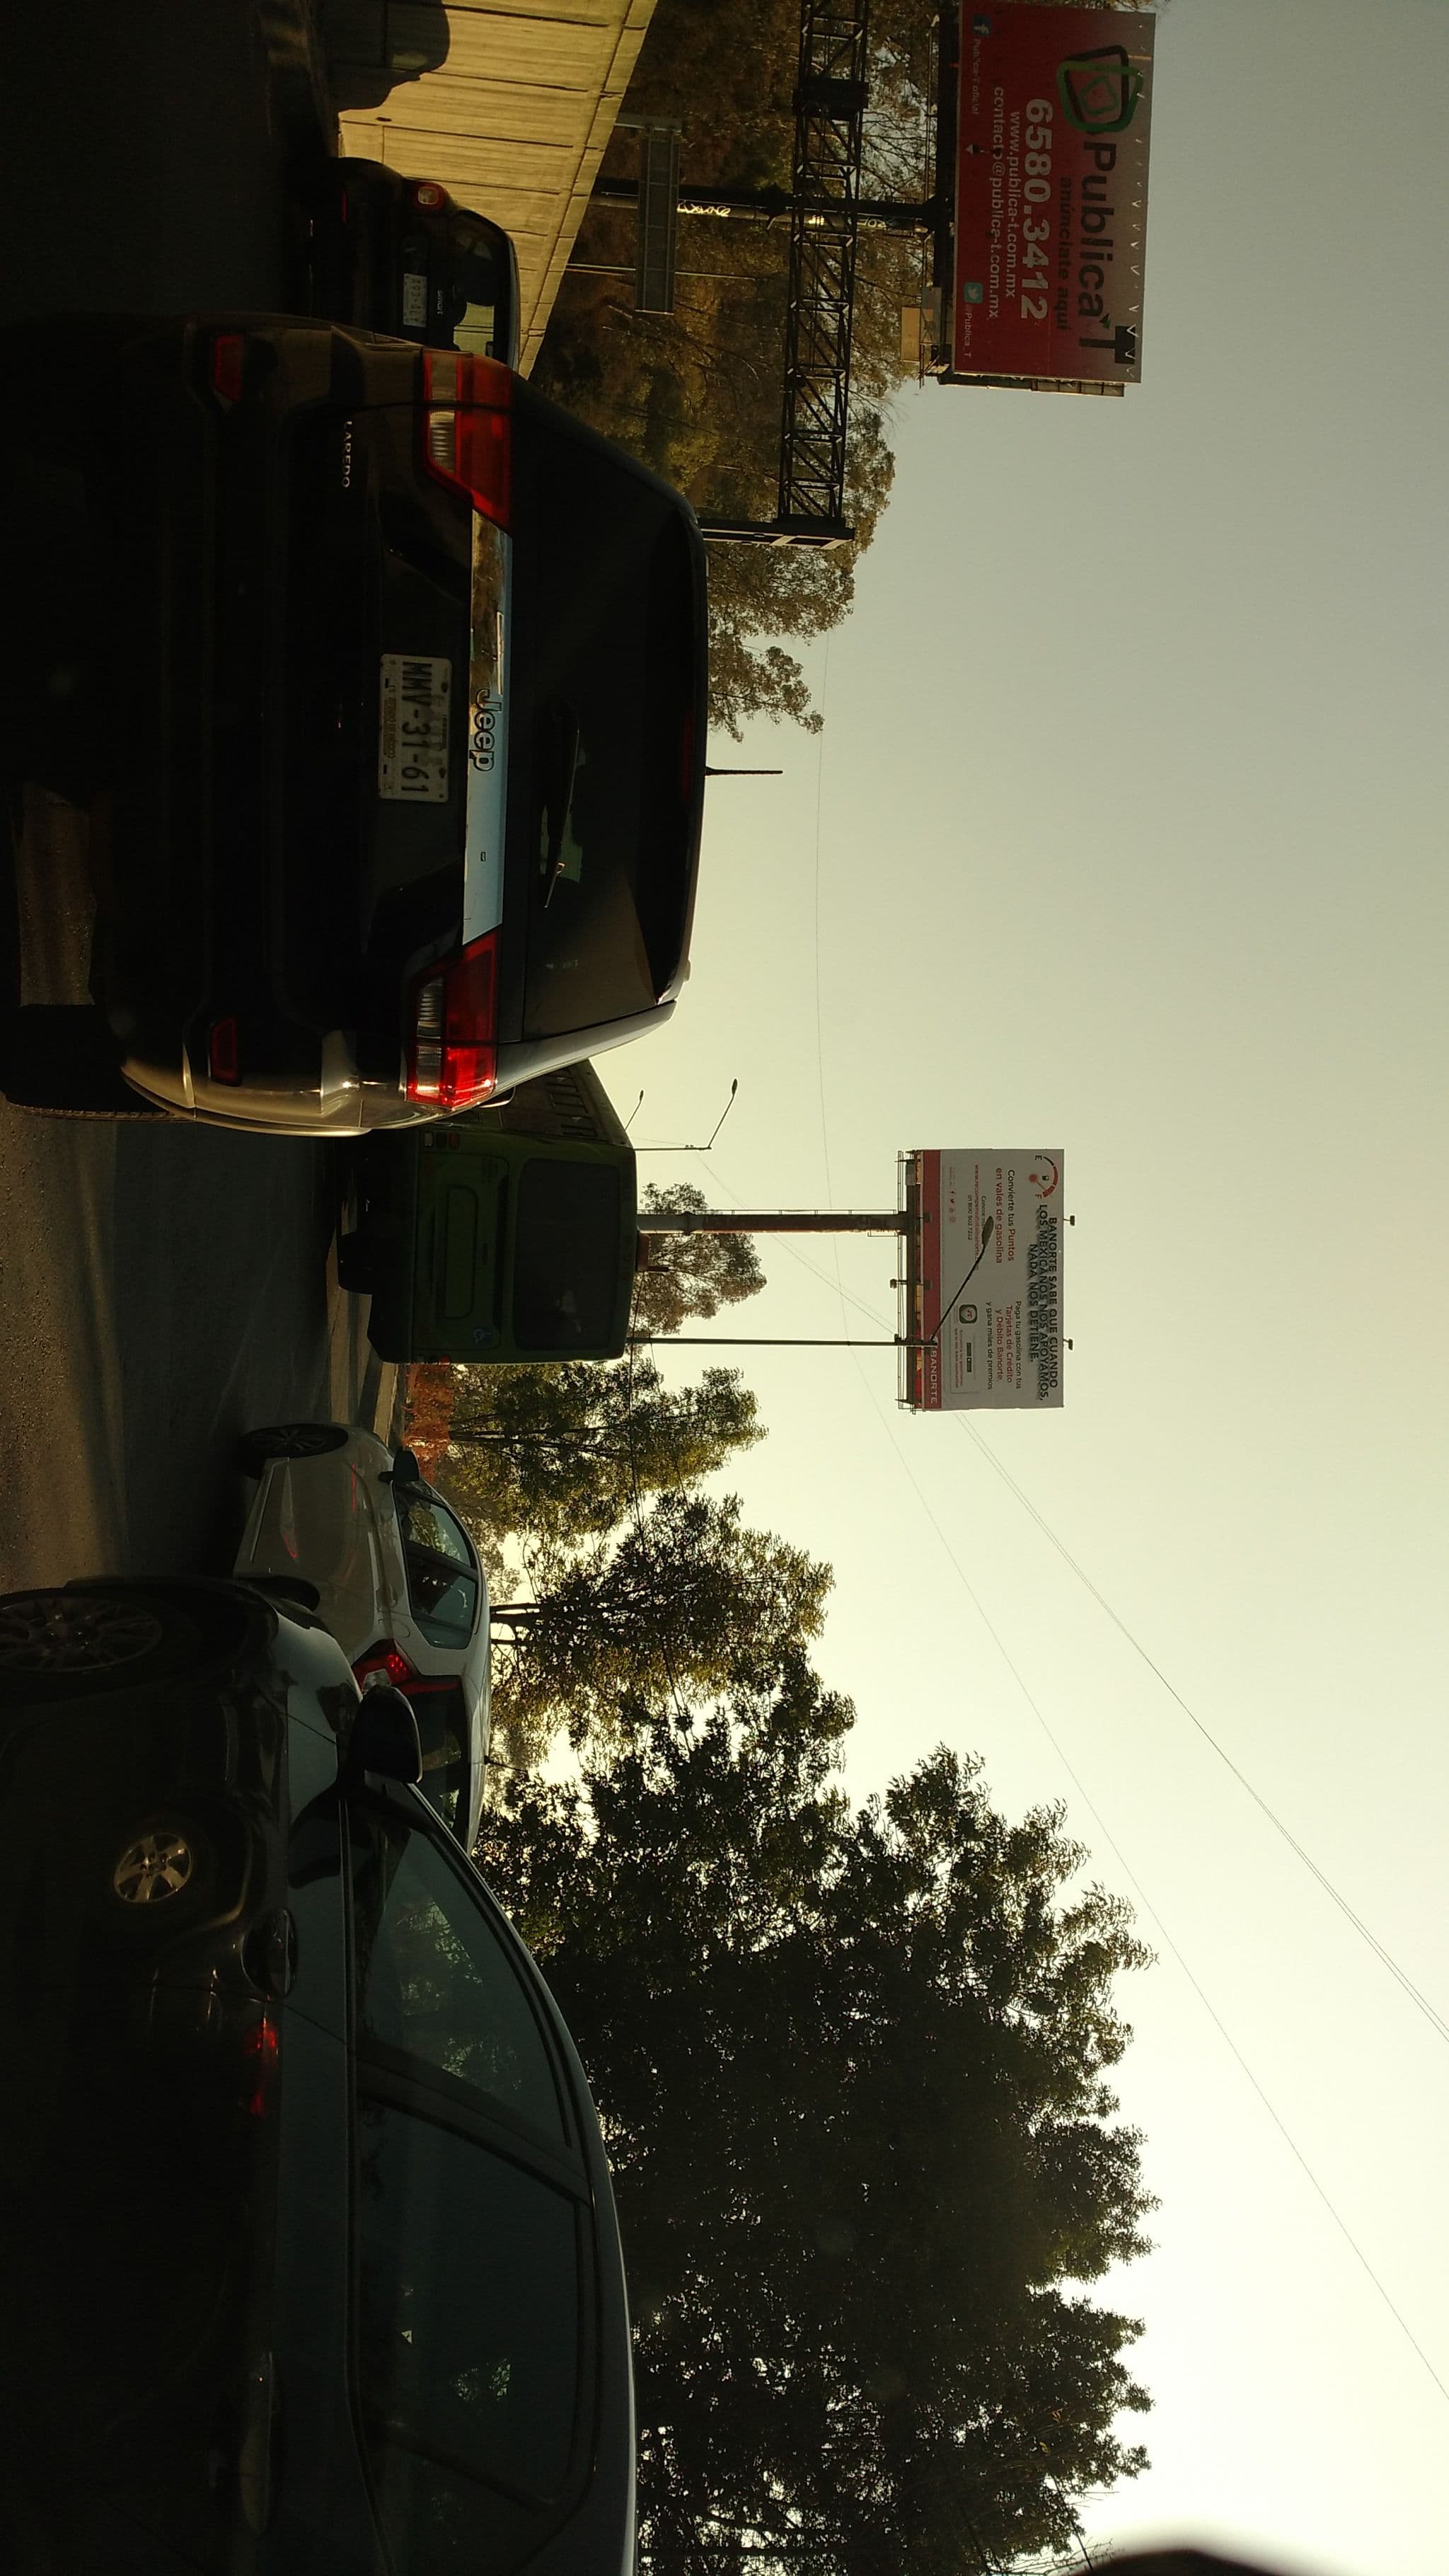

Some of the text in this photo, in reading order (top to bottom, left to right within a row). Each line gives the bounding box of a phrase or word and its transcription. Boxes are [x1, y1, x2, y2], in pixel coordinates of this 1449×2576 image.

[989, 86, 1005, 318] contacto@publica-t.com.mx
[1005, 111, 1021, 299] www.publica-t.com.mx
[1021, 98, 1053, 319] 6580.3412
[341, 420, 352, 488] LAREDO
[401, 662, 432, 792] MMV-31-61
[469, 689, 502, 771] Jeep
[996, 1168, 1003, 1180] en
[995, 1224, 1003, 1263] gasolina
[996, 1209, 1003, 1221] de
[1039, 1204, 1048, 1226] LOS
[1049, 1218, 1057, 1272] BANORTE
[1039, 1230, 1048, 1300] MEXICANOS
[1029, 1244, 1039, 1362] NADA NOS DETIENE.
[1049, 1309, 1058, 1333] QUE
[988, 1349, 993, 1358] de
[1007, 1339, 1013, 1350] de
[1039, 1333, 1049, 1401] APOYAMOS,
[1049, 1337, 1058, 1388] CUANDO
